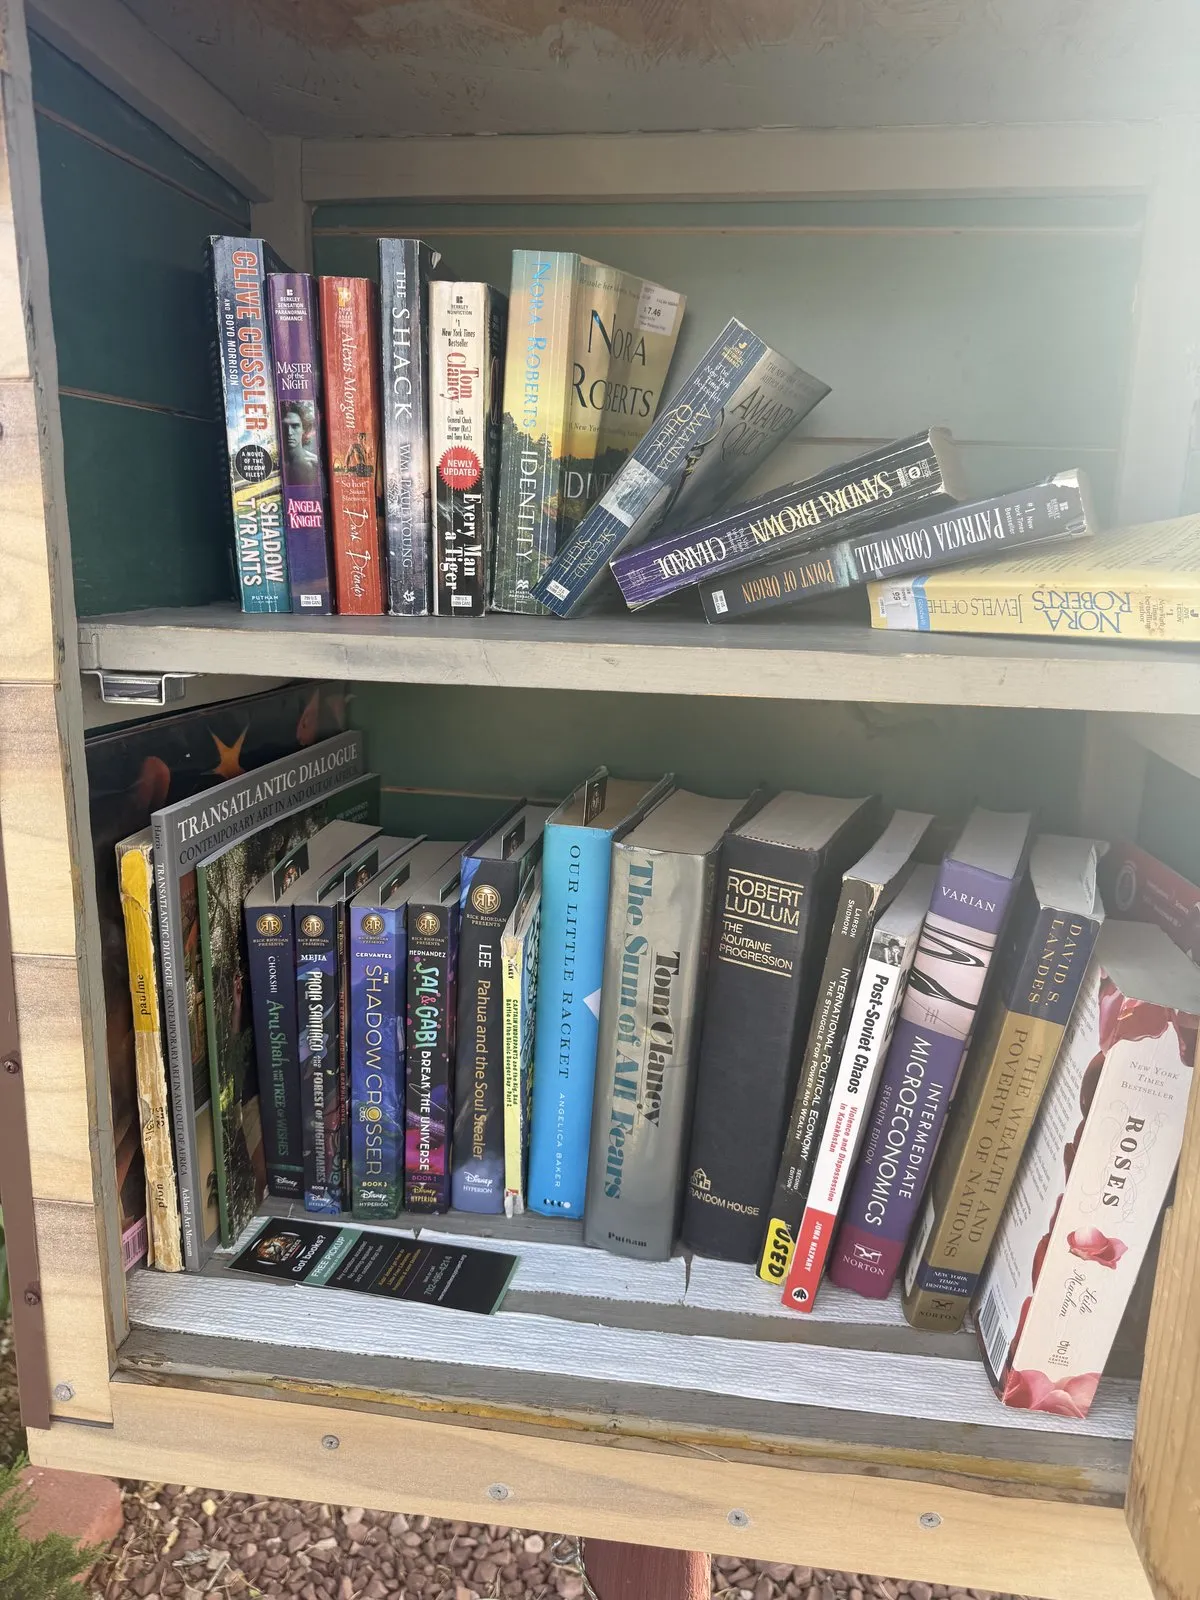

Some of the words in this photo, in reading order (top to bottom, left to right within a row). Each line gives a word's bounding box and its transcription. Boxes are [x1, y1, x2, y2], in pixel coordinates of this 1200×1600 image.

[232, 251, 261, 319] CLIVE
[396, 270, 407, 298] THE
[527, 261, 552, 326] NORA
[225, 314, 235, 337] BOYD
[442, 328, 451, 337] New
[452, 328, 462, 337] York
[463, 328, 476, 338] Times
[448, 338, 468, 348] Bestseller
[588, 309, 646, 366] NORA
[227, 340, 239, 386] MORRISON
[277, 361, 312, 374] MASTER
[340, 332, 358, 377] Alexis
[392, 307, 413, 420] SHACK
[238, 327, 268, 430] CUSSLER
[282, 379, 309, 390] NIGHT
[440, 352, 466, 403] Clancy
[460, 367, 480, 399] Tom
[522, 336, 548, 428] ROBERTS
[571, 362, 654, 418] ROBERTS
[339, 378, 358, 429] Morgan
[657, 403, 712, 470] AMANDA
[443, 467, 478, 477] UPDATED
[448, 460, 474, 468] NEWLY
[287, 498, 323, 514] ANGELA
[516, 450, 538, 563] IDENTITY
[820, 470, 894, 518] SANDRA
[289, 513, 322, 529] KNIGHT
[456, 493, 482, 539] Every
[750, 498, 822, 544] BROWN
[932, 508, 1006, 552] PATRICIA
[237, 497, 262, 587] TYRANTS
[260, 501, 284, 583] SHADOW
[402, 518, 413, 568] YOUNG
[444, 531, 457, 541] a
[560, 536, 592, 573] SIGHT
[574, 527, 617, 578] SECOND
[854, 528, 932, 574] CORNWELL
[440, 546, 464, 590] Tiger
[463, 543, 482, 578] Man
[654, 536, 727, 580] CHARADE
[800, 559, 835, 588] POINT
[741, 578, 782, 604] ORIGIN
[783, 569, 798, 592] OF
[953, 598, 968, 615] OF
[971, 594, 1024, 624] JEWELS
[1032, 590, 1132, 613] ROBERTS
[1042, 610, 1122, 634] NORA
[178, 770, 297, 842] TRANSATLANTIC
[299, 744, 358, 784] DIALOGUE
[179, 810, 256, 865] CONTEMPORARY
[568, 845, 581, 893] OUR
[156, 863, 170, 938] TRANSATLANTIC
[626, 860, 654, 926] The
[724, 894, 800, 927] LUDLUM
[727, 876, 804, 907] ROBERT
[942, 886, 996, 913] VARIAN
[722, 920, 744, 934] THE
[842, 899, 854, 936] SKIDMORE
[851, 908, 862, 938] LAIRSON
[300, 954, 327, 962] MEJIA
[478, 944, 492, 968] LEE
[564, 904, 578, 982] LITTLE
[719, 944, 793, 970] PROGRESSION
[720, 933, 772, 954] AQUITAINE
[1028, 918, 1065, 1004] LANDES
[1054, 924, 1082, 985] DAVID
[162, 939, 174, 988] DIALOGUE
[268, 956, 278, 994] CHOKSHI
[416, 962, 440, 996] SAL
[620, 932, 648, 1008] Sum
[140, 974, 150, 1016] paulme
[305, 971, 322, 1001] PAOLA
[421, 995, 437, 1004] &
[476, 980, 491, 1023] Pahua
[652, 951, 681, 1016] Tom
[826, 980, 836, 998] THE
[166, 988, 180, 1062] CONTEMPORARY
[266, 1000, 284, 1030] Aru
[308, 1003, 324, 1052] SANTIAGO
[366, 965, 383, 1070] SHADOW
[415, 1005, 439, 1048] GABI
[817, 999, 832, 1041] STRUGGLE
[824, 968, 851, 1050] INTERNATIONAL
[858, 974, 890, 1052] Post-Soviet
[269, 1031, 290, 1068] Shah
[476, 1025, 488, 1053] and
[558, 992, 573, 1079] RACKET
[618, 1013, 642, 1048] of
[475, 1056, 488, 1080] the
[813, 1042, 822, 1058] FOR
[312, 1072, 324, 1106] FOREST
[420, 1050, 432, 1090] BREAK
[612, 1049, 640, 1102] All
[636, 1022, 675, 1128] Clancy
[812, 1054, 832, 1106] POLITICAL
[848, 1054, 869, 1094] Chaos
[986, 1028, 1028, 1132] POVERTY
[1016, 1054, 1042, 1098] THE
[1138, 1073, 1164, 1088] TIMES
[1153, 1066, 1180, 1080] YORK
[420, 1092, 431, 1114] THE
[474, 1082, 488, 1112] Soul
[802, 1090, 810, 1106] AND
[873, 1084, 893, 1126] SEVENTH
[1120, 1080, 1174, 1101] BESTSELLER
[473, 1113, 488, 1160] Stealer
[556, 1093, 566, 1148] ANGELICA
[800, 1109, 819, 1160] ECONOMY
[864, 1034, 933, 1227] MICROECONOMICS
[312, 1121, 326, 1184] NIGHTMARES
[419, 1116, 430, 1172] UNIVERSE
[604, 1108, 635, 1200] Fears
[864, 1128, 881, 1165] EDITION
[898, 1082, 944, 1199] INTERMEDIATE
[976, 1136, 993, 1164] OF
[986, 1107, 1025, 1194] WEALTH
[180, 1147, 188, 1176] AFRICA
[464, 1172, 493, 1187] Disney
[554, 1153, 563, 1188] BAKER
[793, 1168, 802, 1190] SECOND
[1102, 1114, 1146, 1208] ROSES
[158, 1183, 168, 1208] plon
[310, 1193, 331, 1203] Disney
[359, 1190, 387, 1200] Disney
[410, 1195, 437, 1203] HYPERION
[412, 1186, 436, 1195] Disney
[463, 1186, 492, 1194] HYPERION
[688, 1188, 726, 1208] RANDOM
[726, 1201, 760, 1216] HOUSE
[812, 1221, 822, 1241] JOMA
[944, 1170, 982, 1260] NATIONS
[968, 1200, 992, 1244] AND
[292, 1256, 309, 1272] Got
[304, 1234, 326, 1261] books?
[311, 1260, 328, 1277] FREE
[324, 1236, 346, 1260] PICKUP
[768, 1228, 791, 1278] USED
[842, 1255, 886, 1277] NORTON
[933, 1270, 948, 1279] NEW
[949, 1273, 968, 1282] YORK
[938, 1277, 960, 1286] TIMES
[1058, 1268, 1085, 1318] Meacham
[918, 1310, 958, 1321] NORTON
[1079, 1288, 1098, 1316] Leila
